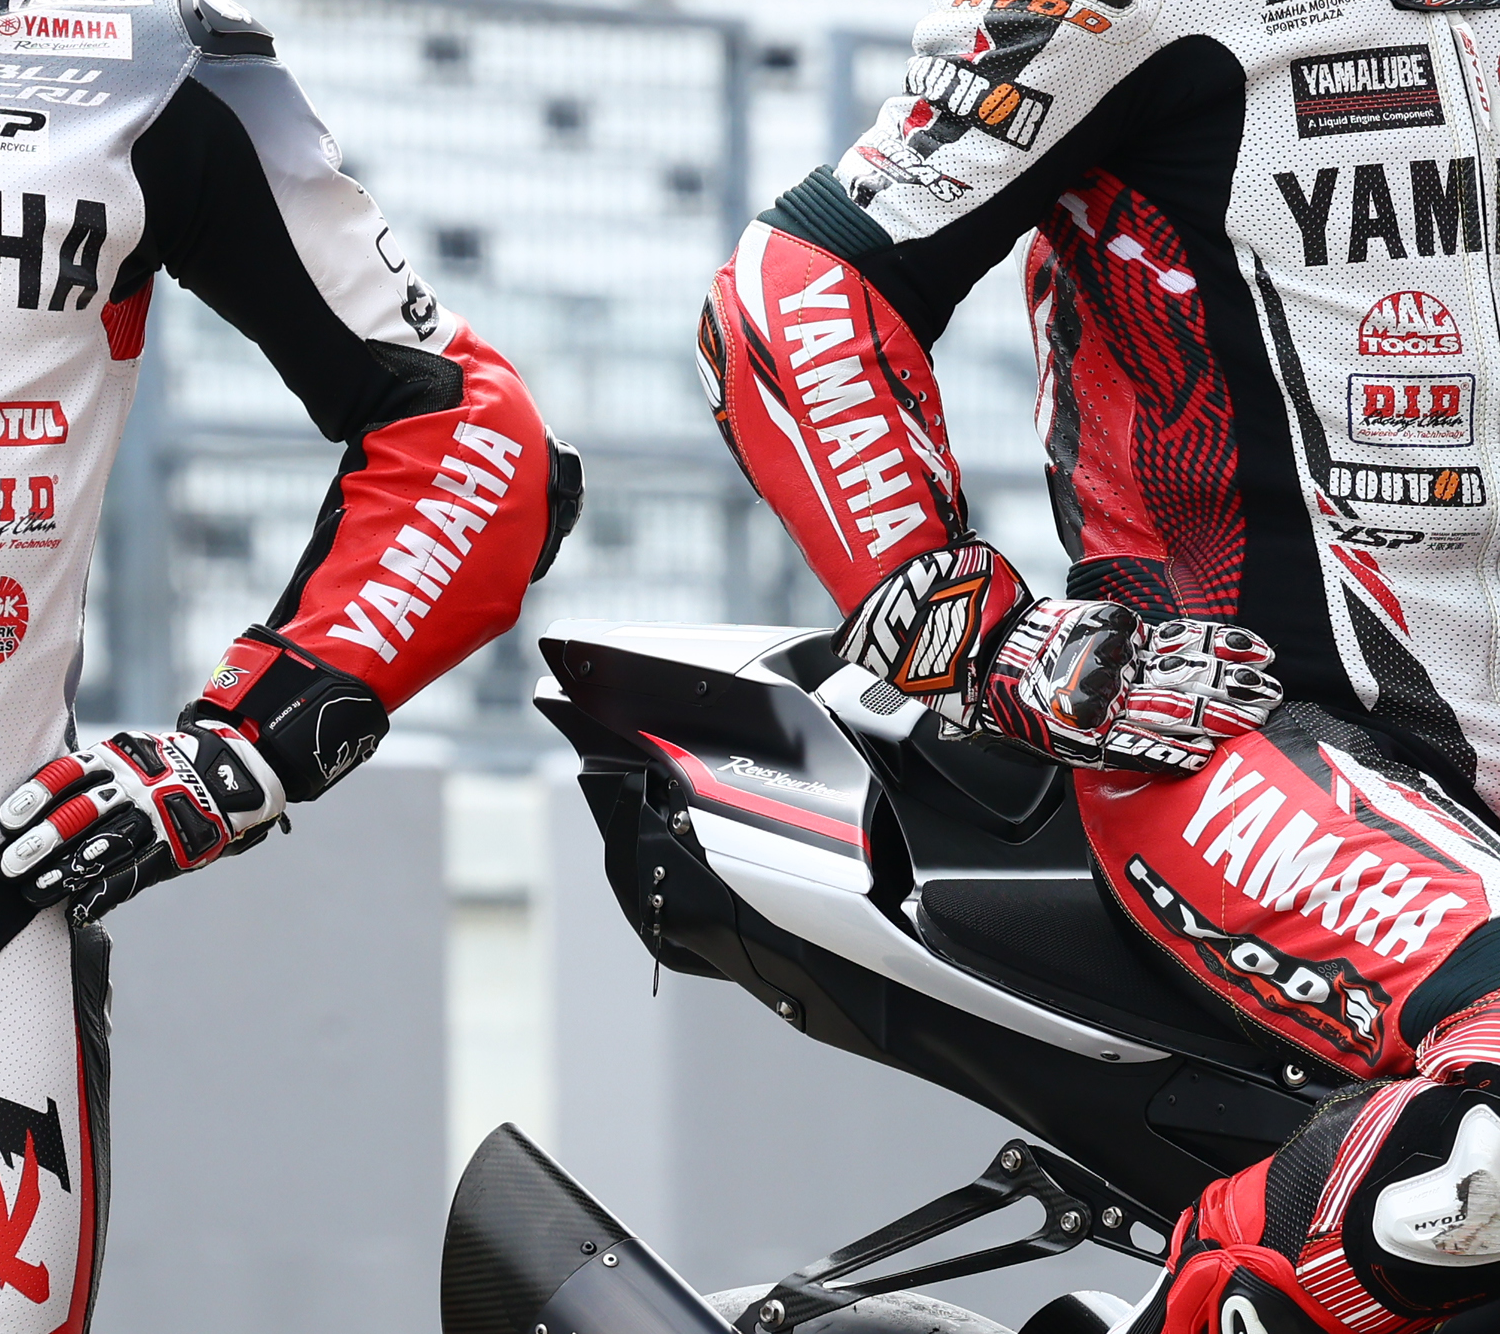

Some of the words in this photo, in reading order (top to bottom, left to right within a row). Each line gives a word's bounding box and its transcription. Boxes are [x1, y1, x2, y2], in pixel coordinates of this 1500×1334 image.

[22, 15, 119, 40] YAMAHA
[1260, 1, 1308, 25] YAMAHA
[1265, 16, 1308, 37] SPORTS
[1309, 8, 1345, 26] PLAZA
[1300, 53, 1429, 96] YAMALUBE
[1307, 119, 1317, 129] A
[1318, 115, 1348, 129] Liquid
[1350, 113, 1381, 126] Engine
[1382, 108, 1435, 123] Component
[1365, 291, 1455, 337] MAC
[1362, 336, 1462, 355] TOOLS
[778, 263, 928, 560] YAMAHA
[1357, 428, 1400, 439] Powered
[1402, 428, 1414, 439] by
[1414, 429, 1466, 441] Technology
[7, 538, 63, 551] Technology
[327, 421, 525, 665] YAMAHA
[1326, 519, 1426, 550] YSP
[1181, 751, 1469, 965] YAMAHA
[1129, 858, 1331, 1004] HYOD
[1414, 1213, 1468, 1232] HYOD
